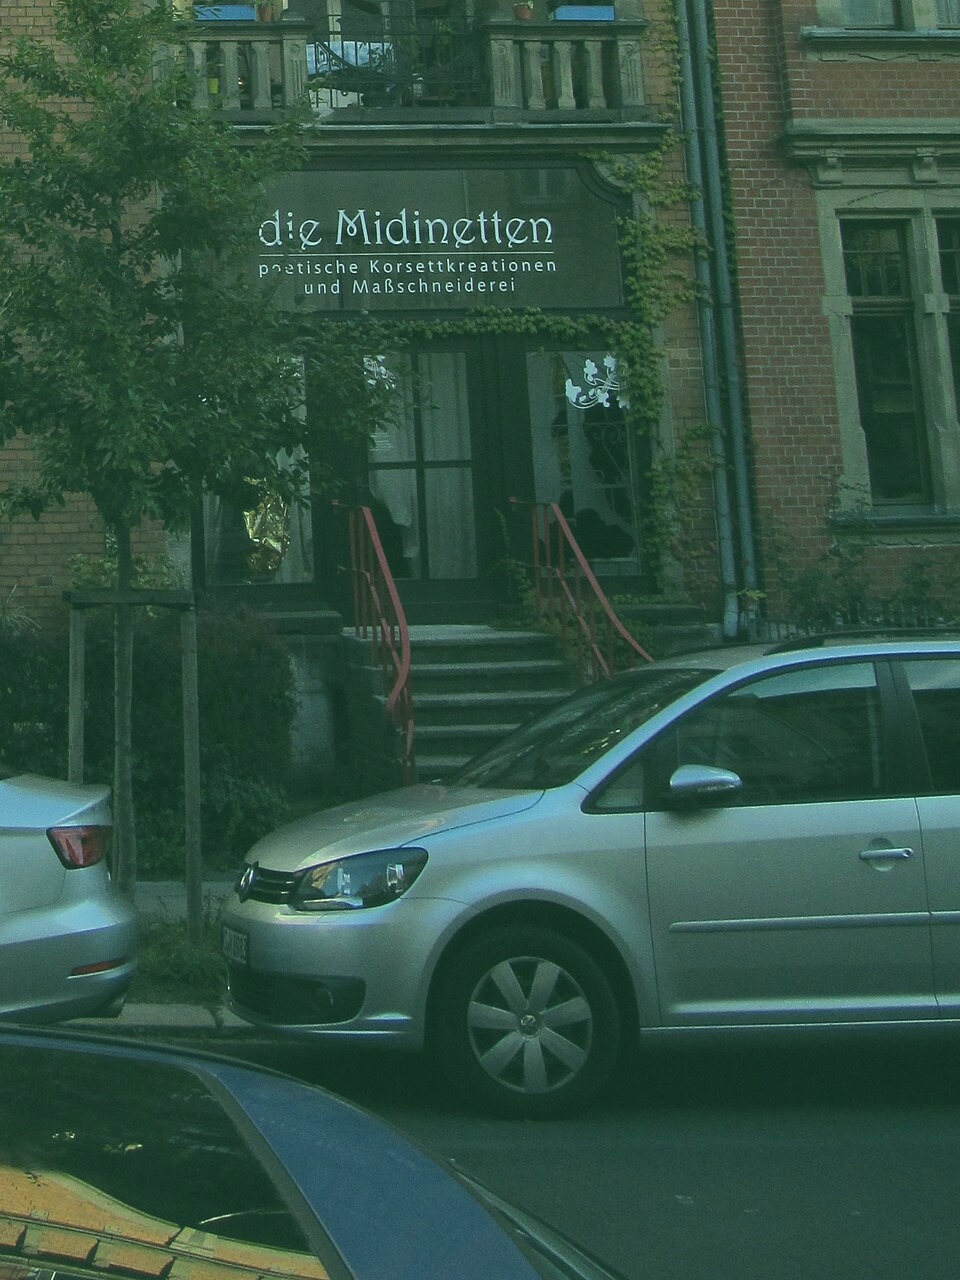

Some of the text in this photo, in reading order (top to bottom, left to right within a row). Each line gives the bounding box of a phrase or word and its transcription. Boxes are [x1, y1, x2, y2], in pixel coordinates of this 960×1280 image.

[258, 207, 553, 251] die Midinetten
[369, 258, 556, 274] Korsettkreationen
[304, 277, 515, 295] und Maßschneiderei
